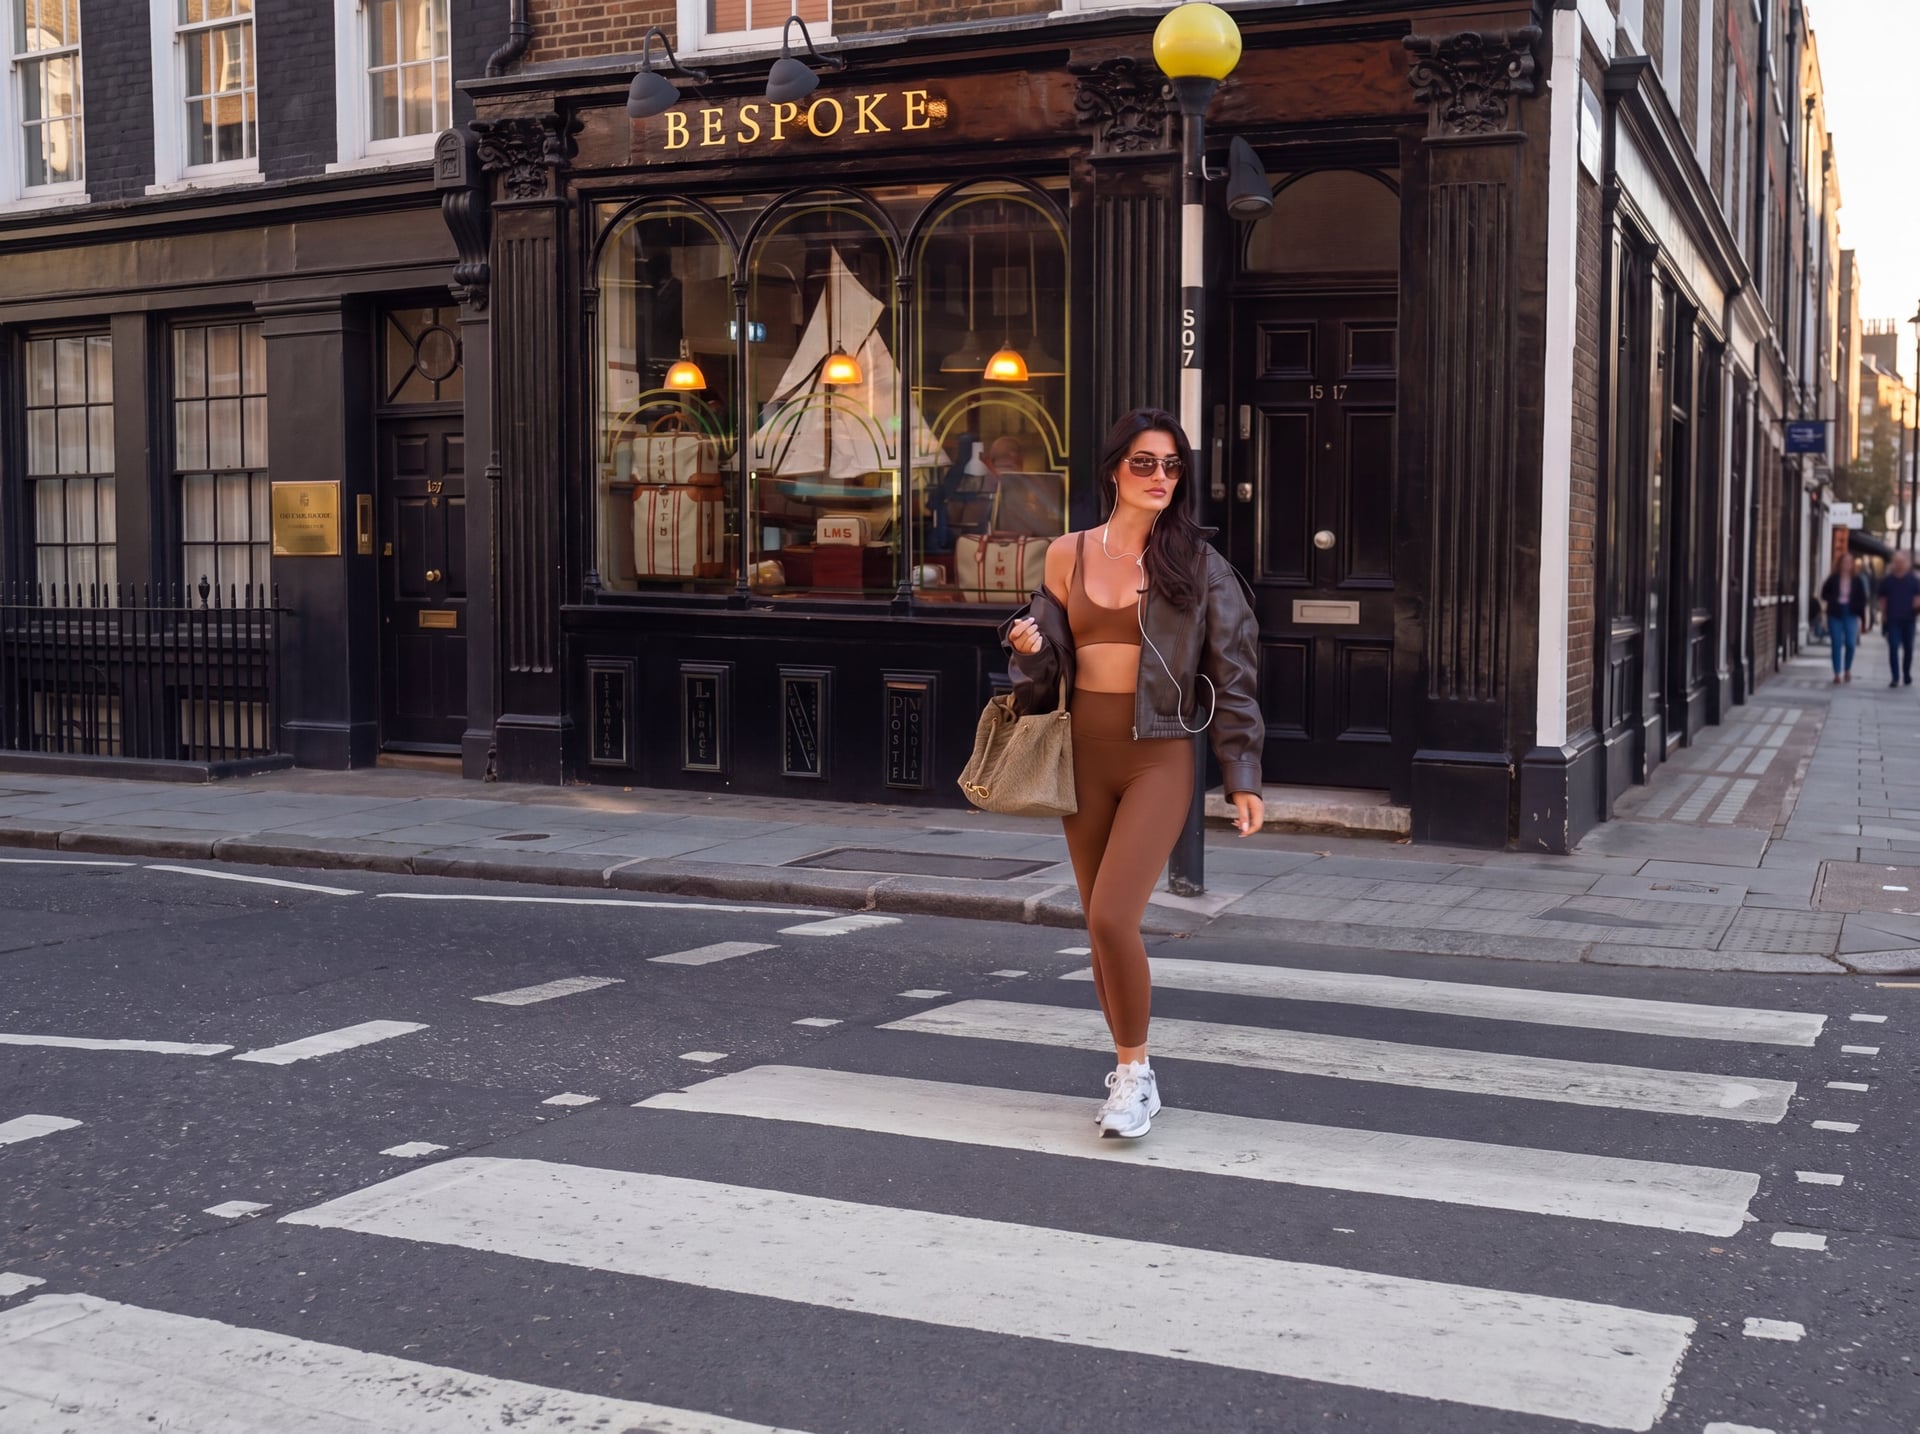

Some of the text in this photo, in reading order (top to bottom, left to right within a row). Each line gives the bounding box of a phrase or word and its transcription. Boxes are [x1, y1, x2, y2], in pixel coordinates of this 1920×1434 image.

[664, 90, 931, 149] BESPOKE
[1182, 309, 1195, 366] S07
[1310, 384, 1348, 399] 15 17
[823, 527, 852, 538] LMS
[891, 696, 904, 779] POSTE
